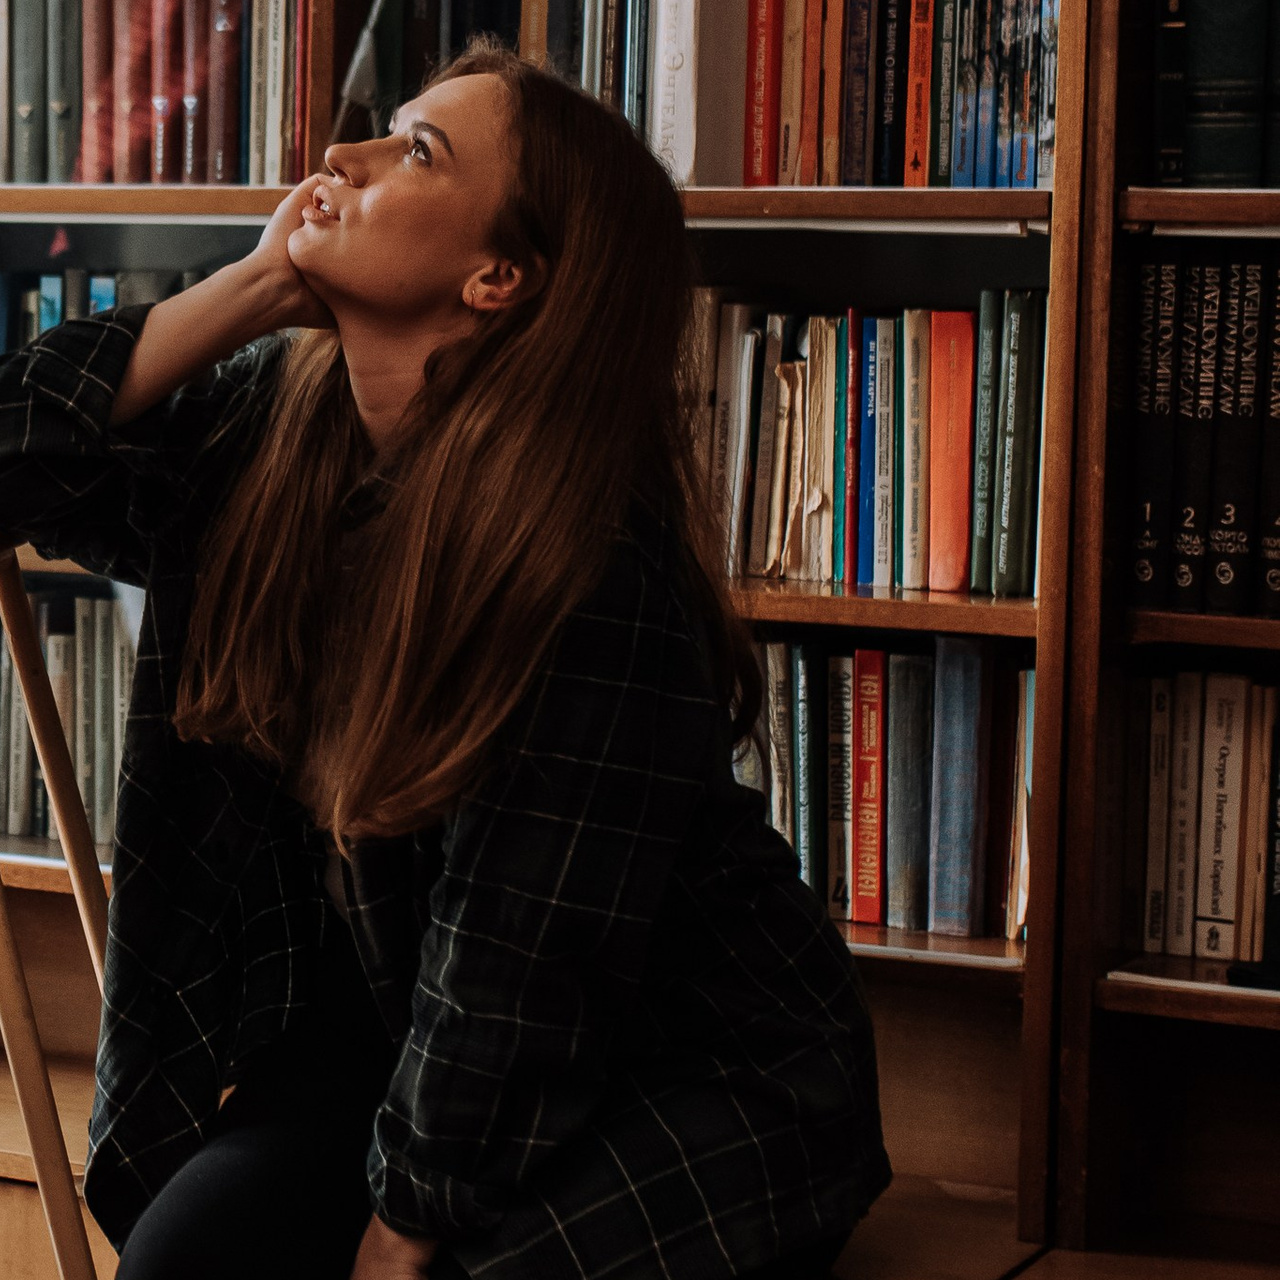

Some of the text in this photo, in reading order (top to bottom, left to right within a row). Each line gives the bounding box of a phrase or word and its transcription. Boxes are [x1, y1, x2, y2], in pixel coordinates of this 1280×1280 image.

[883, 71, 895, 125] МНЕНИЯ
[884, 56, 895, 67] О
[1135, 264, 1157, 414] МУЗЫКАЛЬНАЯ
[1153, 264, 1177, 417] ЭНЦИКЛОПЕДИЯ
[1178, 267, 1201, 418] МУЗЫКАЛЬНАЯ
[1197, 267, 1221, 419] ЭНЦИКЛОПЕДИЯ
[1218, 264, 1241, 416] МУЗЫКАЛЬНАЯ
[1237, 264, 1262, 417] ЭНЦИКЛОПЕДИЯ
[1144, 501, 1151, 523] 1
[1183, 506, 1195, 528] 2
[1221, 503, 1235, 525] 3
[832, 876, 850, 911] 4
